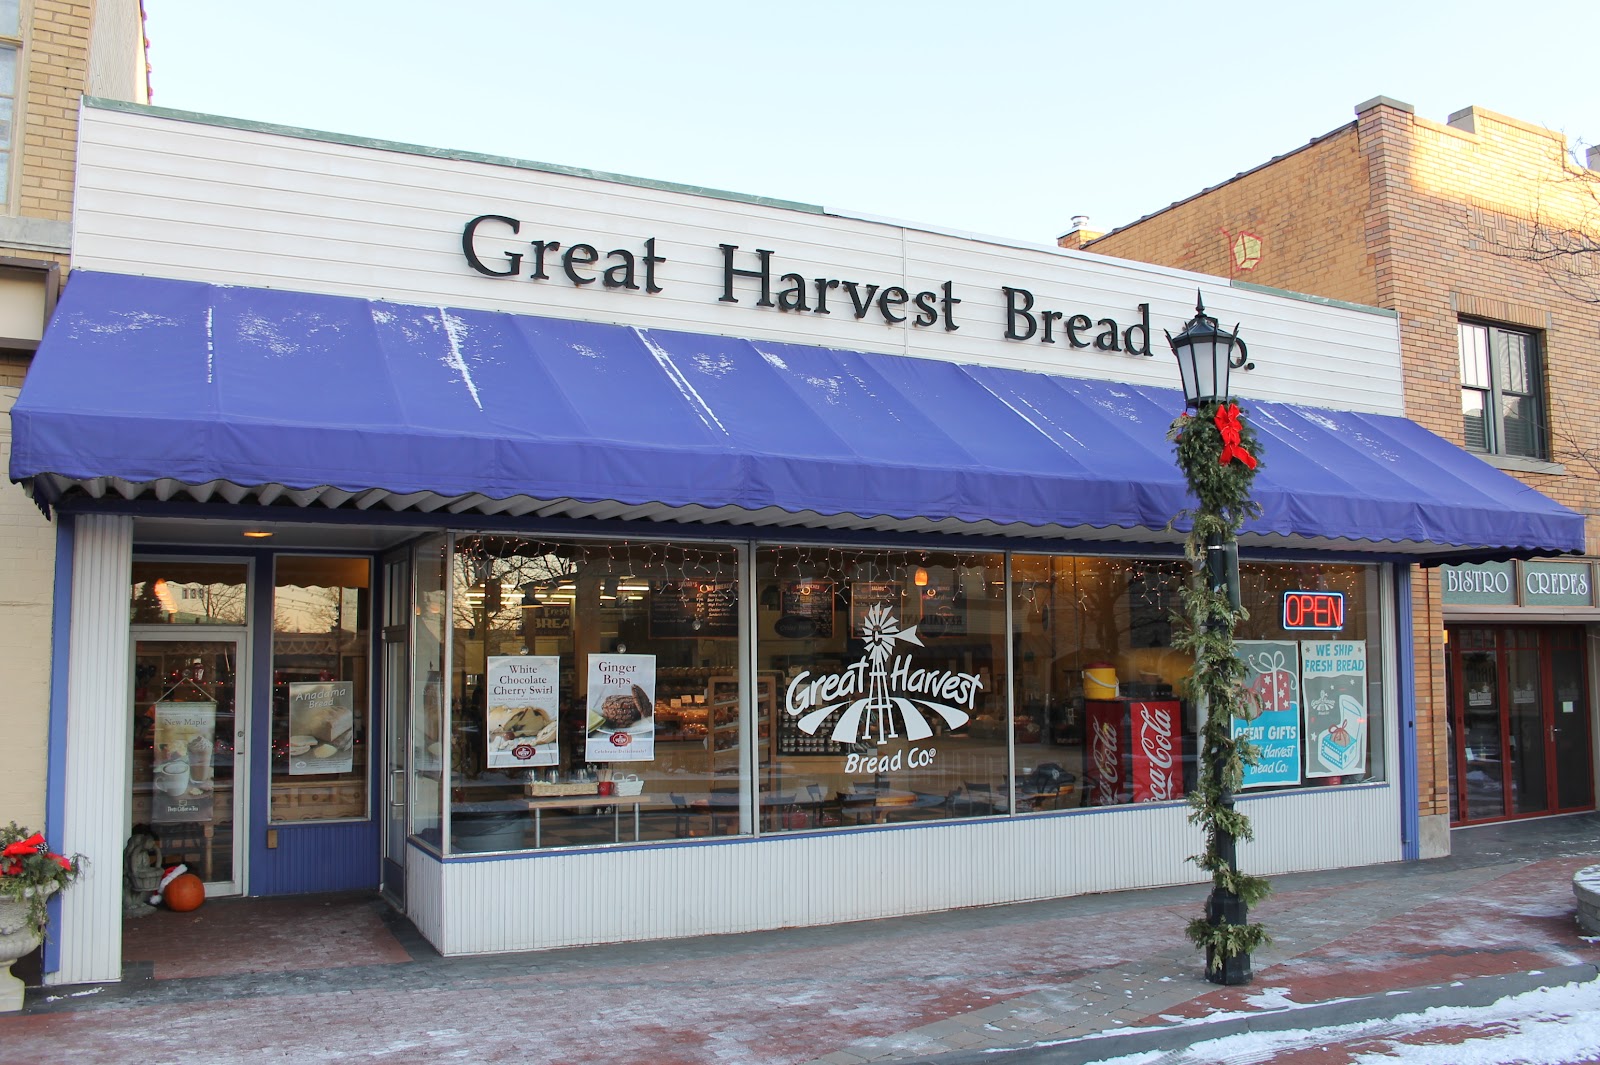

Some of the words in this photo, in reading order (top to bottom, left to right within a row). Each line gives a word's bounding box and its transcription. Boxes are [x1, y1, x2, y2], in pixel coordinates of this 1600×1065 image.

[463, 214, 667, 294] Great
[718, 243, 962, 332] Harvest
[1001, 287, 1154, 357] Bread
[1446, 569, 1510, 594] BISTRO
[1526, 571, 1588, 596] CREPES
[184, 588, 204, 599] 139
[1286, 594, 1342, 627] OPEN
[1315, 644, 1331, 657] WE
[1333, 643, 1354, 657] SHIP
[509, 665, 538, 674] White
[598, 661, 637, 676] Ginger
[1304, 659, 1333, 672] FRESH
[1336, 659, 1365, 672] BREAD
[499, 675, 547, 685] Chocolate
[602, 674, 631, 688] Bops
[786, 655, 869, 716] Great
[890, 654, 984, 710] Harvest
[295, 688, 346, 701] Anadama
[493, 685, 527, 697] Cherry
[529, 685, 553, 695] Swirl
[308, 699, 334, 709] Bread
[164, 718, 182, 726] New
[184, 717, 207, 727] Maple
[1268, 725, 1297, 740] GIFTS
[1263, 743, 1296, 758] Harvest
[844, 749, 902, 774] Bread
